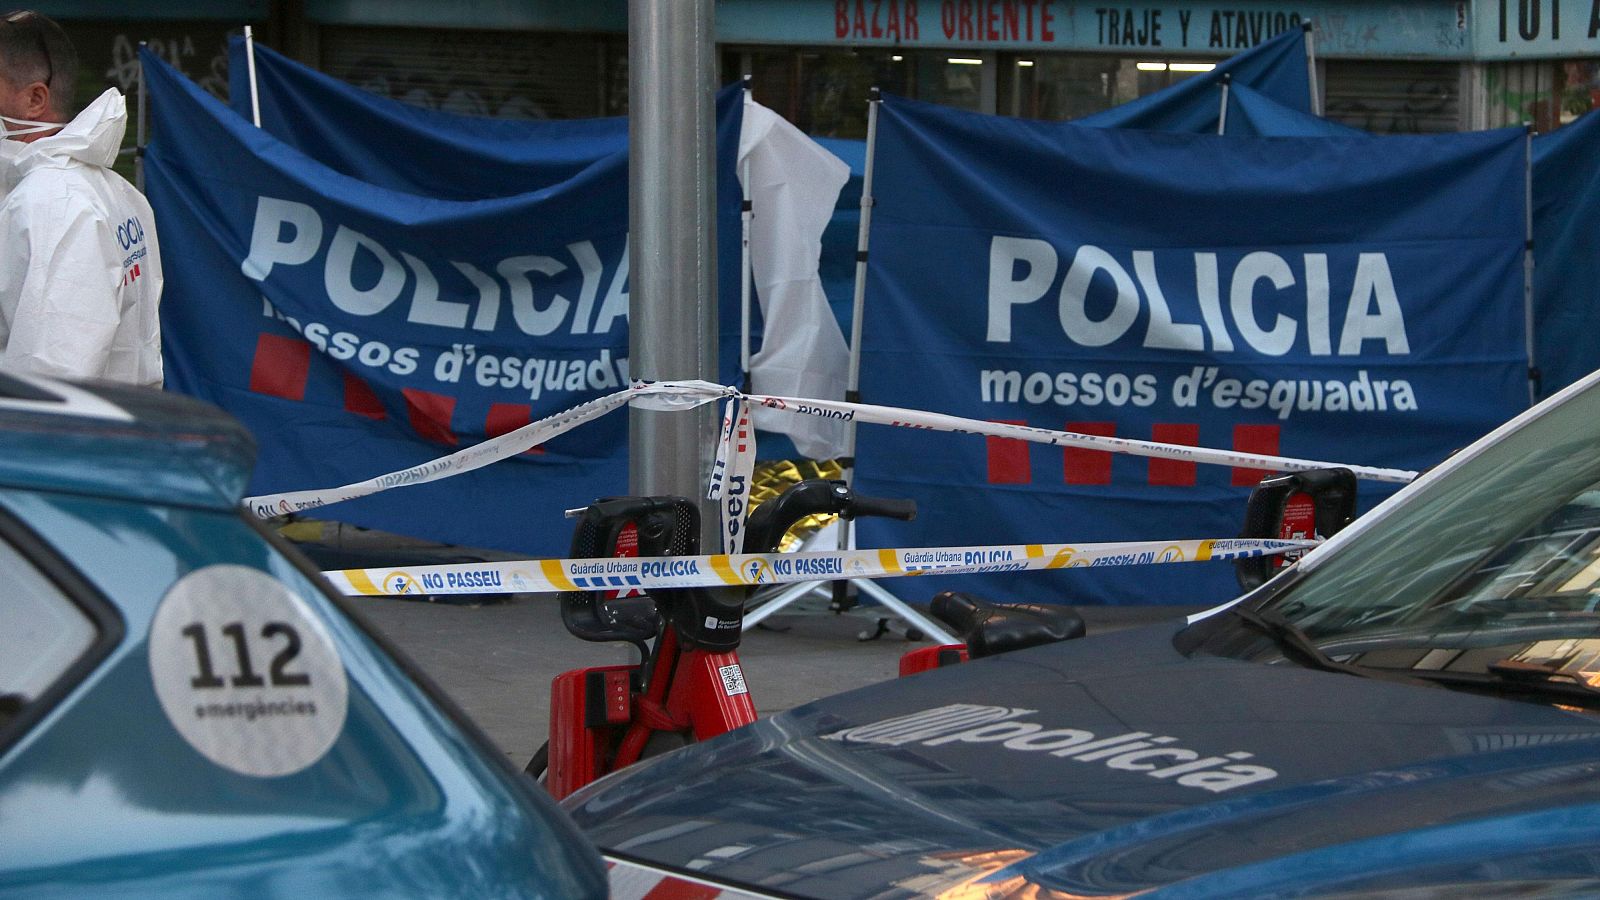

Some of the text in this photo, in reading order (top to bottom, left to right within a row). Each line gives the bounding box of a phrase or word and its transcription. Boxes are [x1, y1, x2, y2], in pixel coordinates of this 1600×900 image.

[835, 0, 1054, 41] BAZAR ORIENTE
[1096, 8, 1161, 46] TRAJE
[1179, 10, 1192, 47] Y
[986, 235, 1410, 356] POLICIA
[980, 366, 1418, 420] mossos d'esquadra
[570, 559, 700, 578] Guàrdia Urbana POLICIA
[773, 557, 843, 575] NO PASSEU
[904, 552, 934, 564] Guàrdia
[935, 551, 962, 562] Urbana
[421, 570, 501, 589] NO PASSEU
[182, 620, 311, 690] 112
[922, 721, 1279, 793] policia
